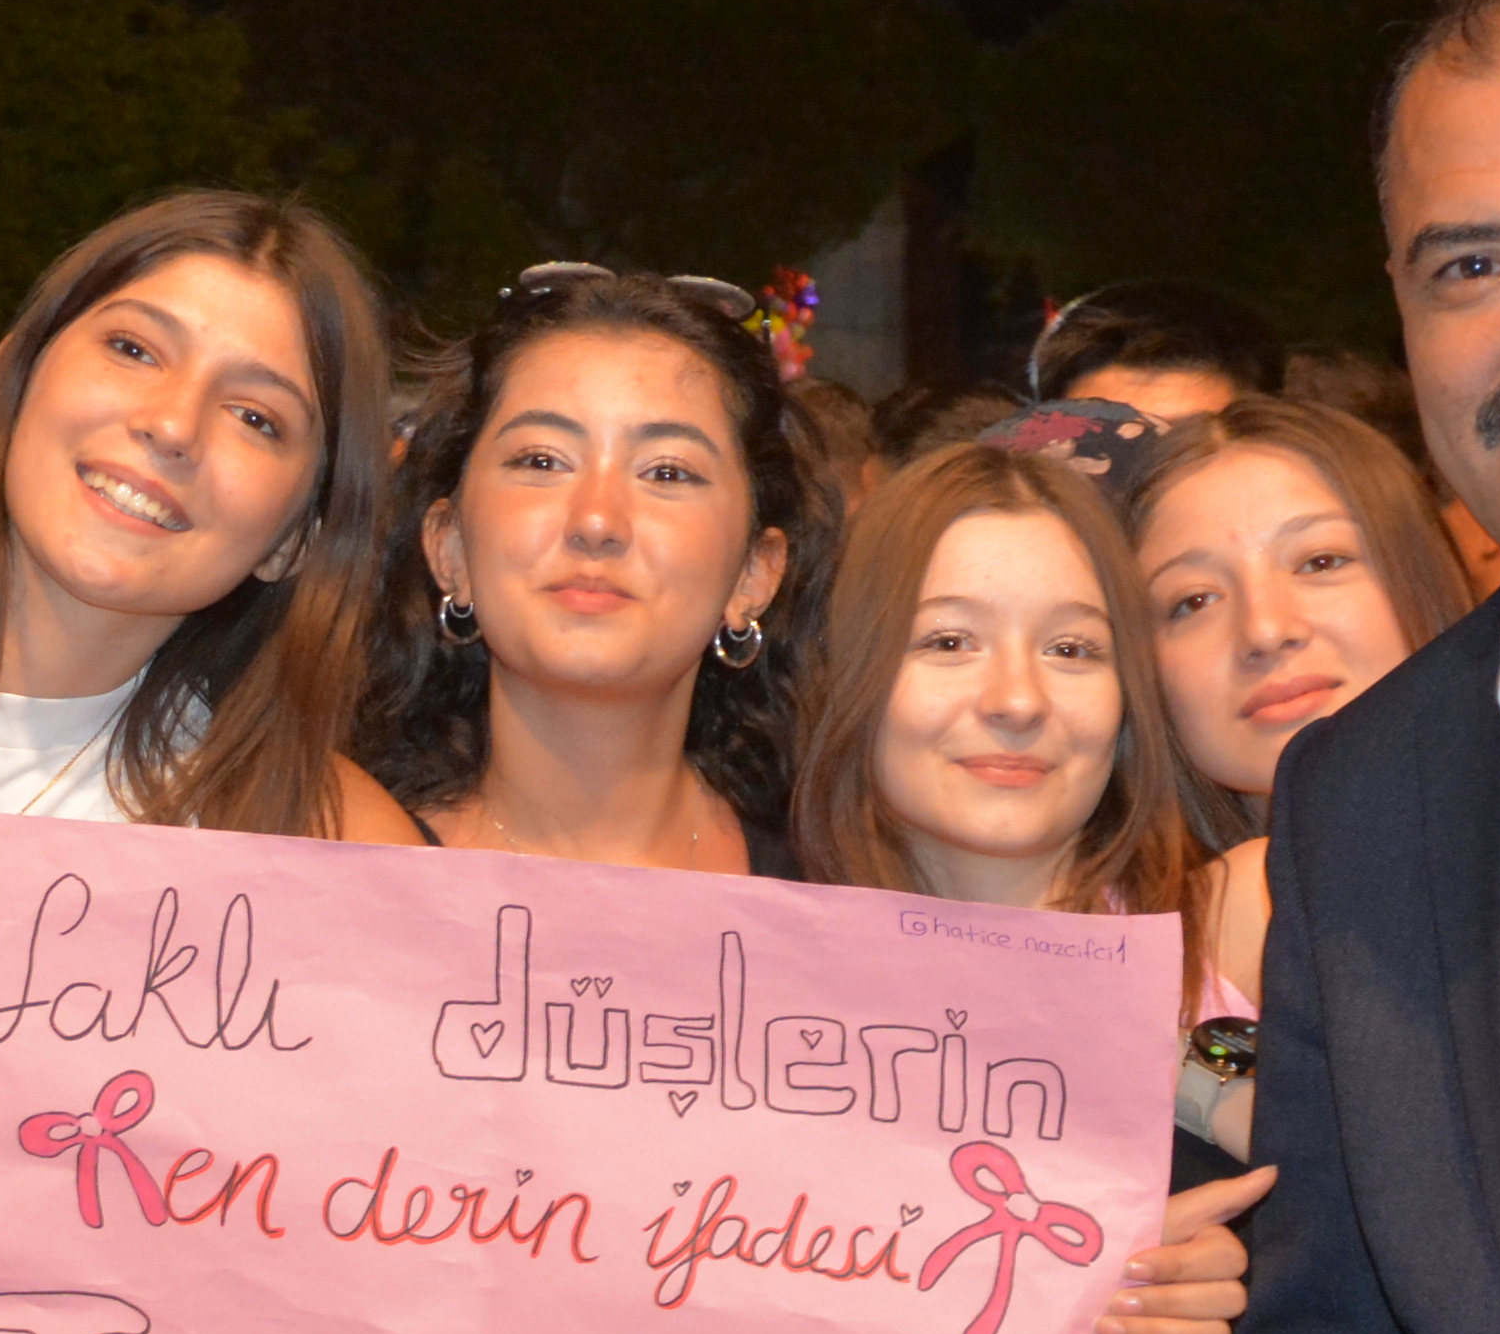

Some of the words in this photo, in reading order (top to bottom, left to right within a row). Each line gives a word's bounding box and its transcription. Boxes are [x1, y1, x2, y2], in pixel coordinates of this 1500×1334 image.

[432, 903, 1068, 1143] düşlerin
[164, 1147, 286, 1240] en
[322, 1147, 600, 1263] derin
[641, 1173, 925, 1309] ifadesi
